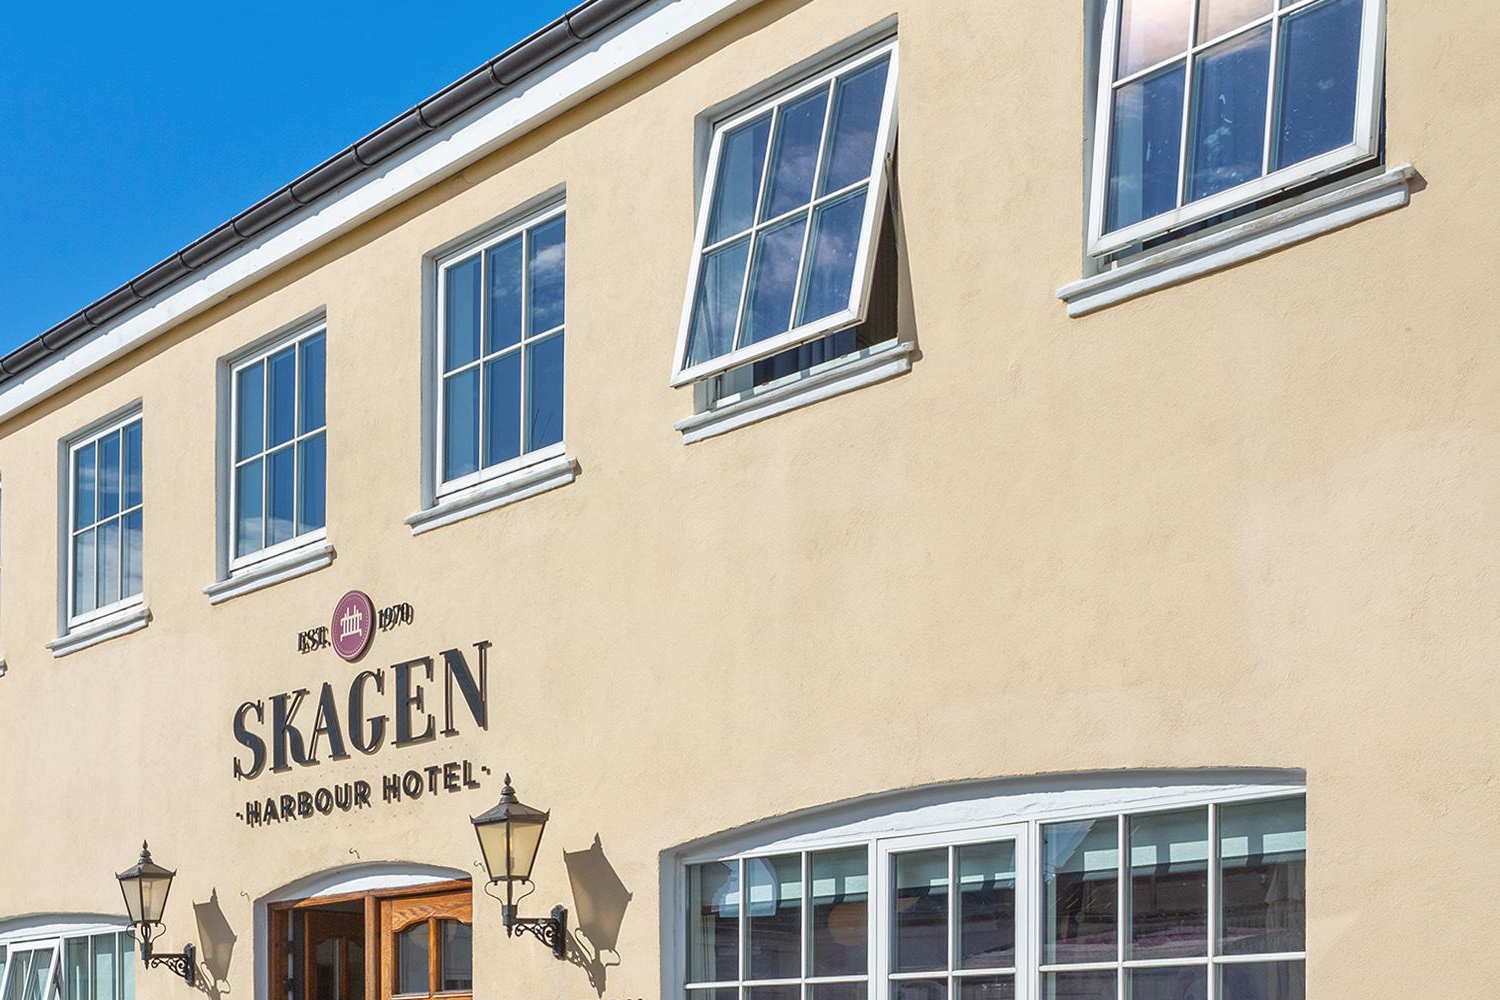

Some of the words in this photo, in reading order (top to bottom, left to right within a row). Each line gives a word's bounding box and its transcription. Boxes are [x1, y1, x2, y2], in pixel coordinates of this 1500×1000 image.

[377, 602, 414, 632] 1970
[233, 640, 492, 780] SKAGEN
[246, 779, 372, 828] HARBOUR
[382, 760, 480, 803] HOTEL
